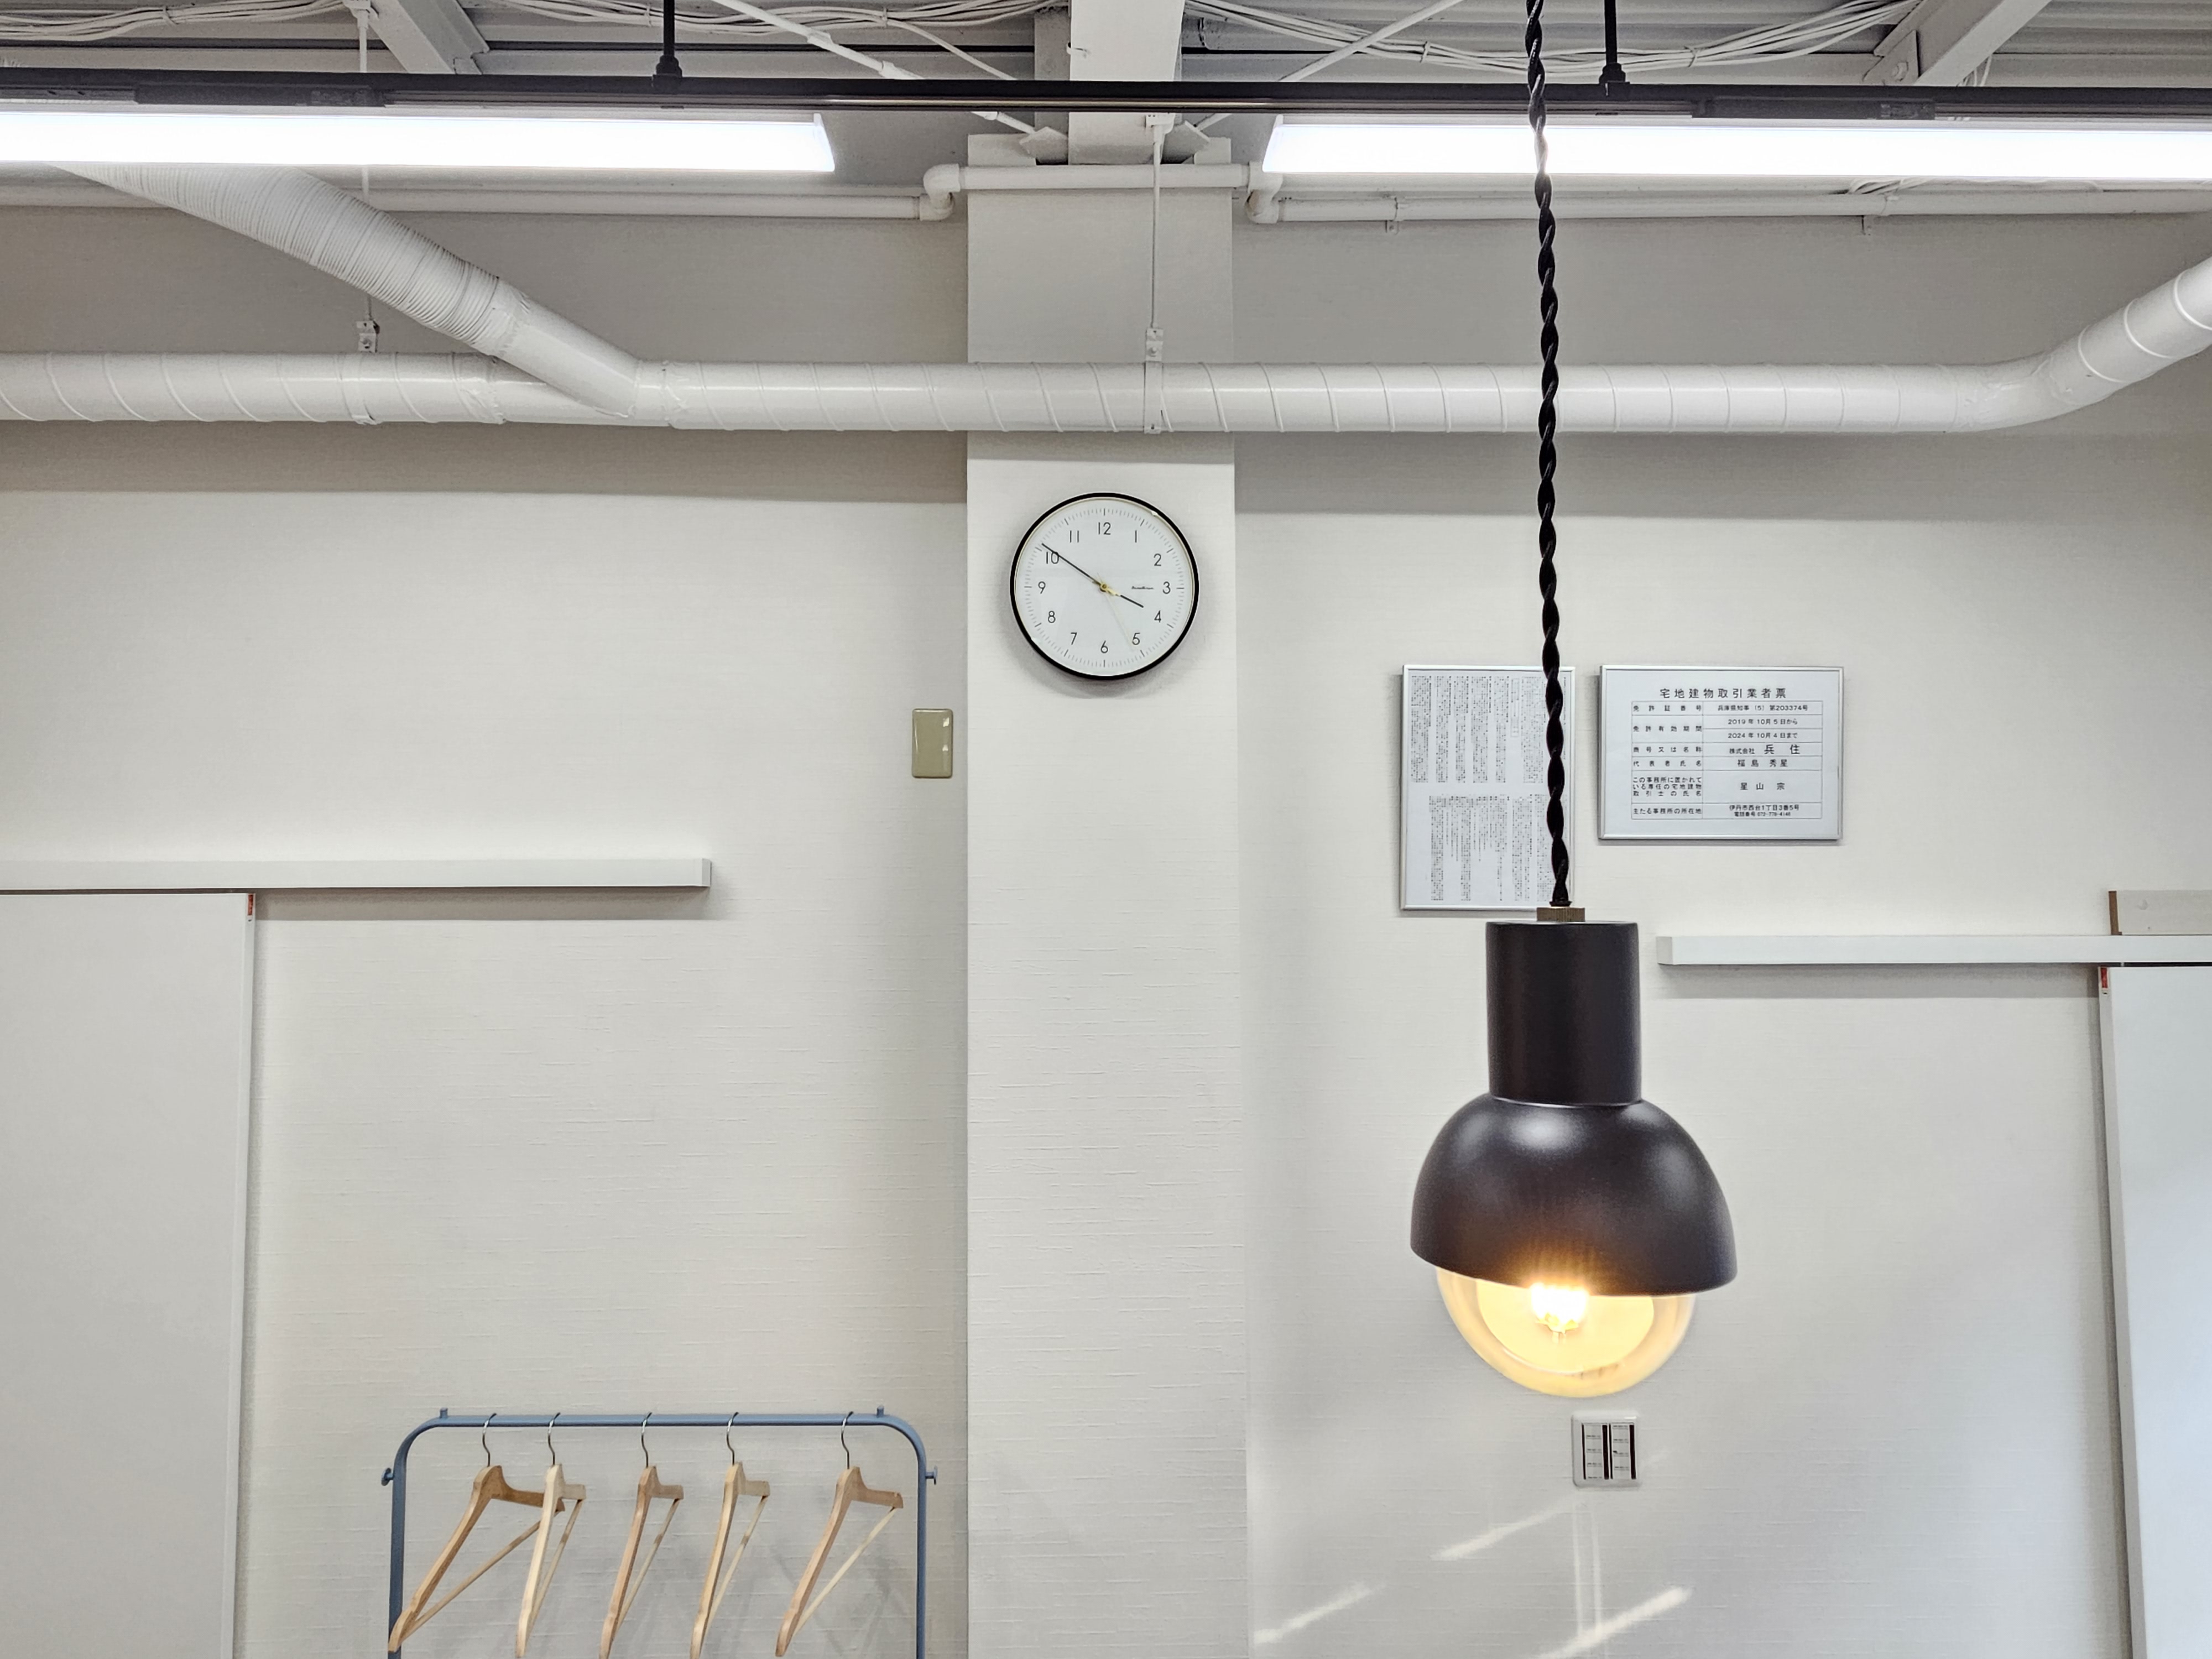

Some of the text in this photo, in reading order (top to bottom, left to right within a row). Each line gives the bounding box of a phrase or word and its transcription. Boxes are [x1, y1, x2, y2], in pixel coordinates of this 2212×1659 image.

[1098, 521, 1111, 535] 12
[1069, 530, 1079, 542] 11
[1046, 551, 1060, 564] 10
[1154, 553, 1162, 566] 2
[1037, 581, 1046, 594] 9
[1162, 581, 1171, 594] 3
[1047, 611, 1056, 623] 8
[1154, 610, 1162, 623] 4
[1071, 632, 1077, 645] 7
[1132, 632, 1140, 645] 5
[1100, 640, 1108, 654] 6
[1660, 688, 1786, 699] 宅地建物取引業者票
